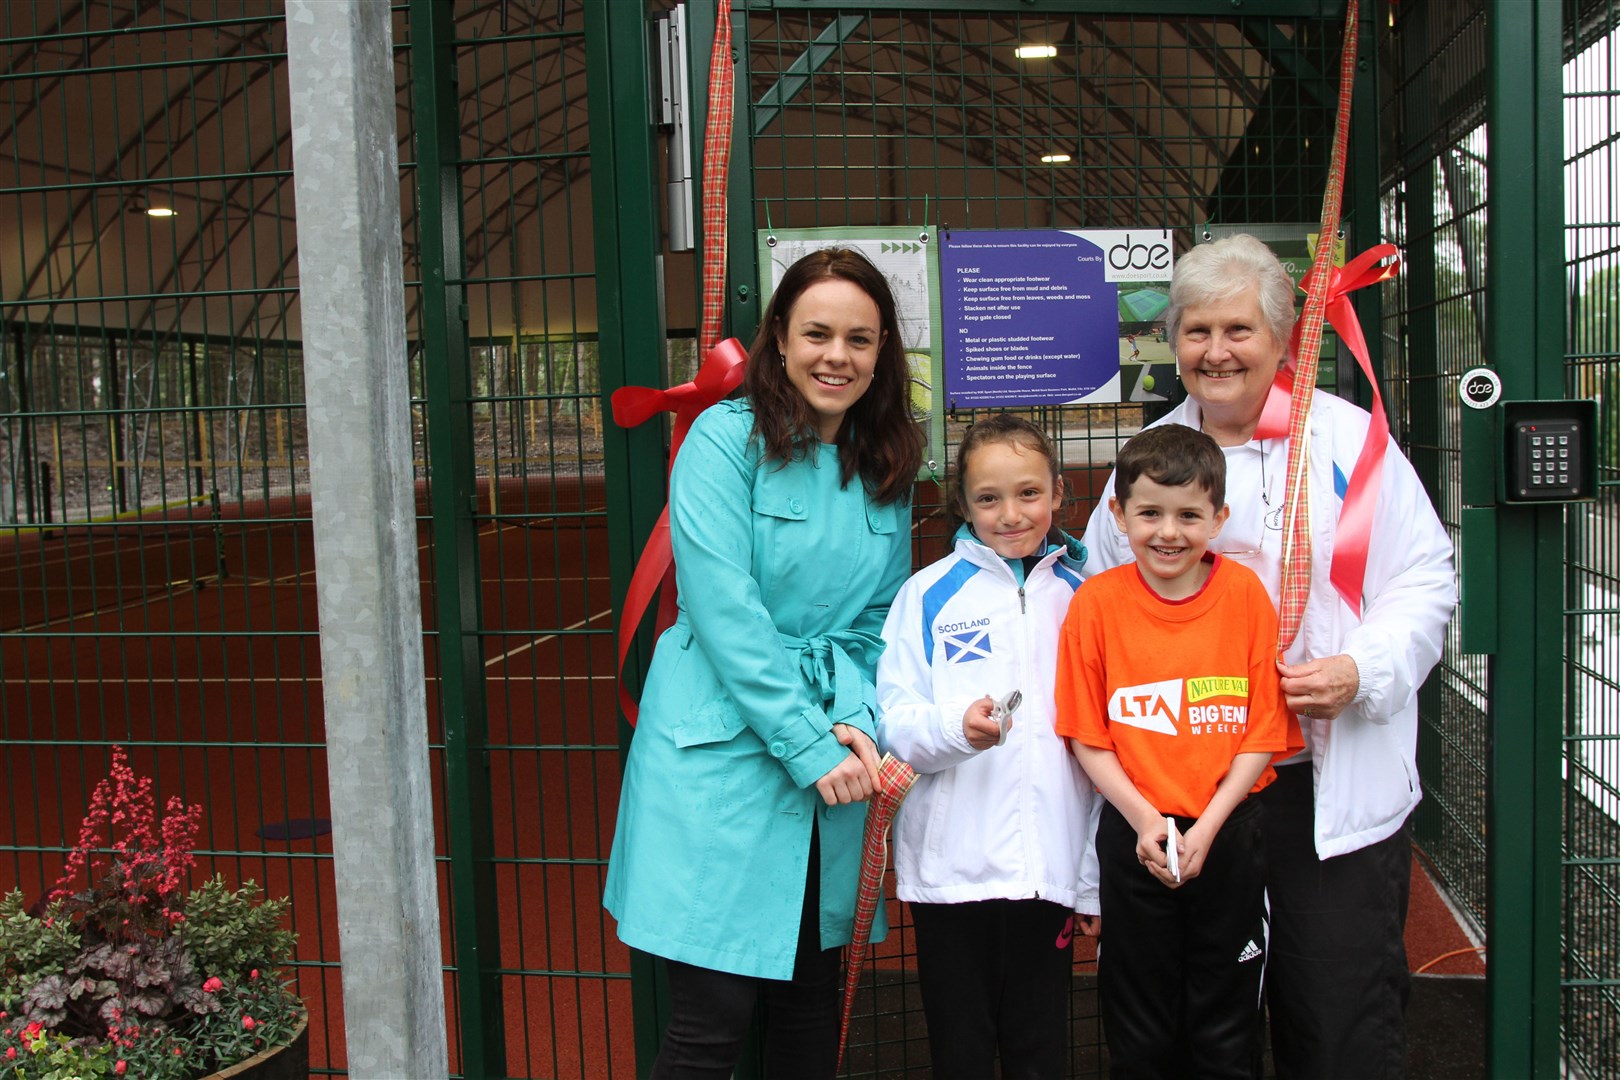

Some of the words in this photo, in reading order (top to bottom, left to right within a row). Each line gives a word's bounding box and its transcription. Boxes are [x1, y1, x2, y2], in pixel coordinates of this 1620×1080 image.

[938, 618, 990, 633] SCOTLAND
[1191, 679, 1229, 698] NATURE
[1120, 694, 1179, 722] LTA
[1188, 704, 1219, 724] BIG
[1238, 949, 1262, 963] adidas
